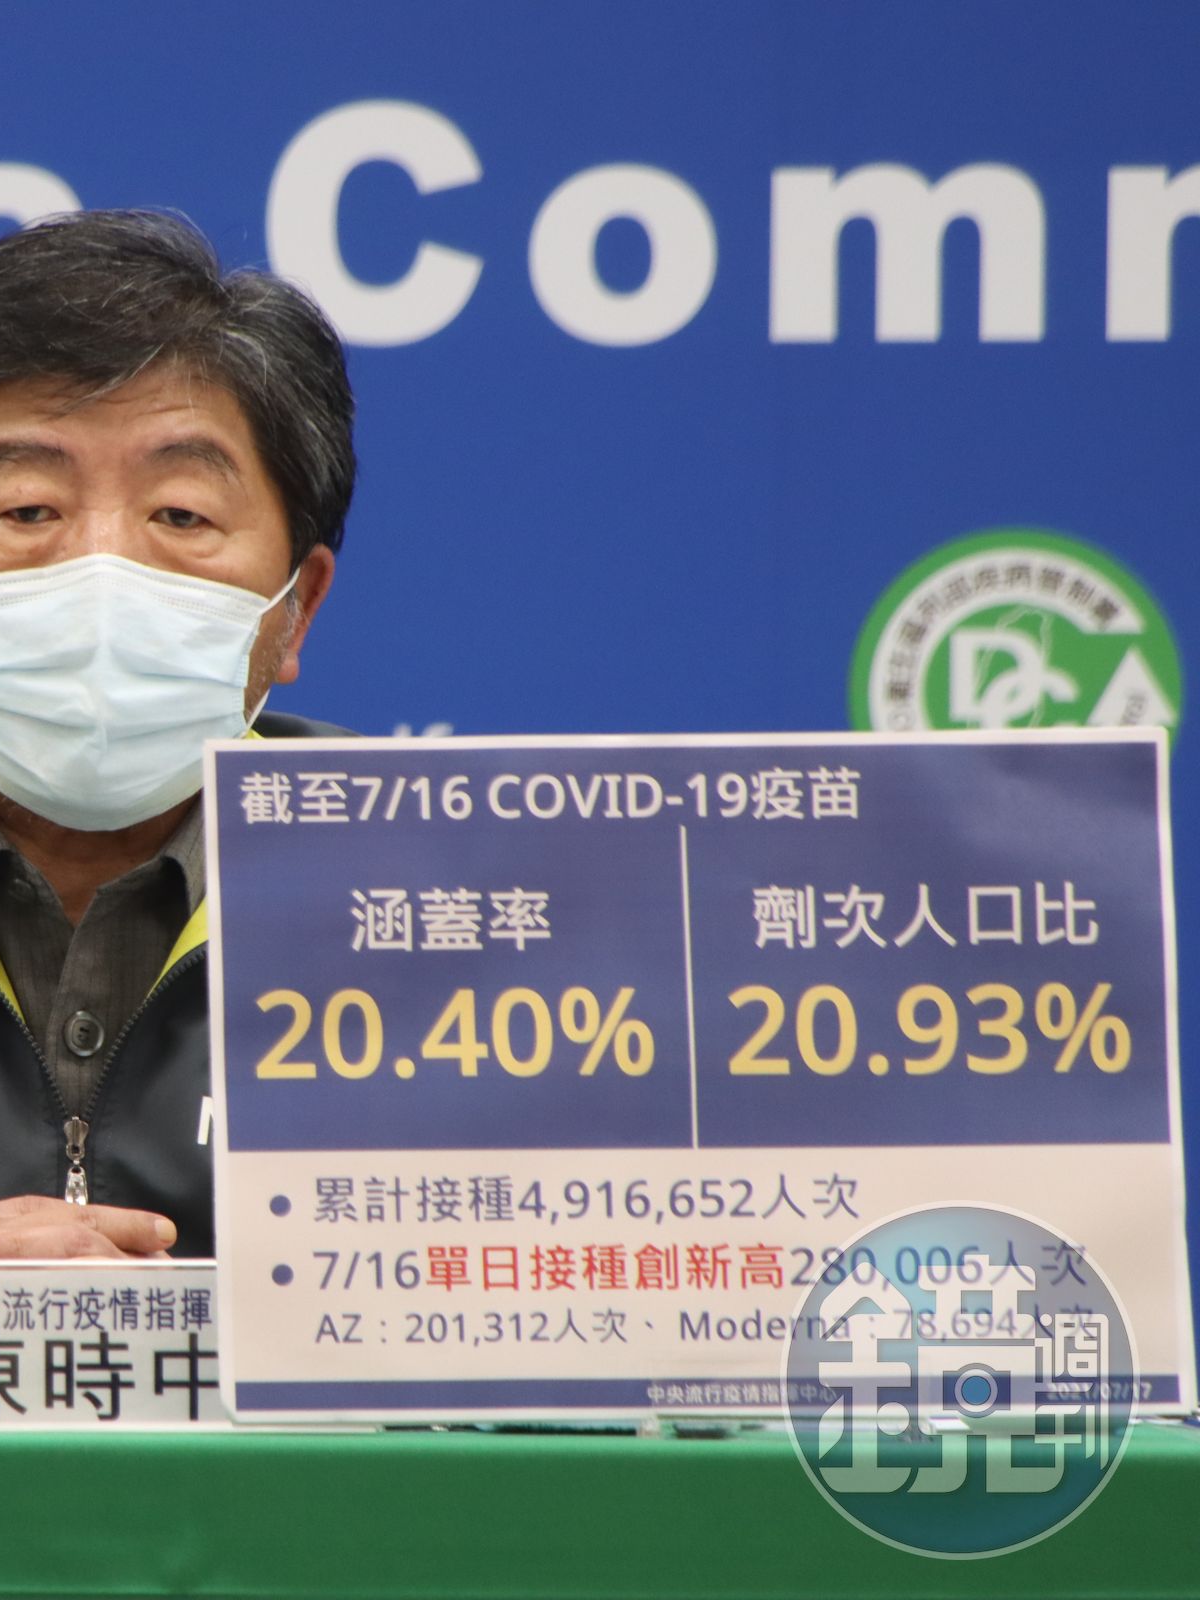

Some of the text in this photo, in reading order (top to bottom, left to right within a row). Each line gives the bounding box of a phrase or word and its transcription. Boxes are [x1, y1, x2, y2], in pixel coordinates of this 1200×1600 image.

[350, 887, 552, 952] 涵蓋率
[752, 881, 1099, 949] 劑次人口比
[255, 985, 656, 1080] 20.40%
[727, 981, 1133, 1077] 20.93%
[314, 1173, 860, 1226] 累計接種4,916,652人次
